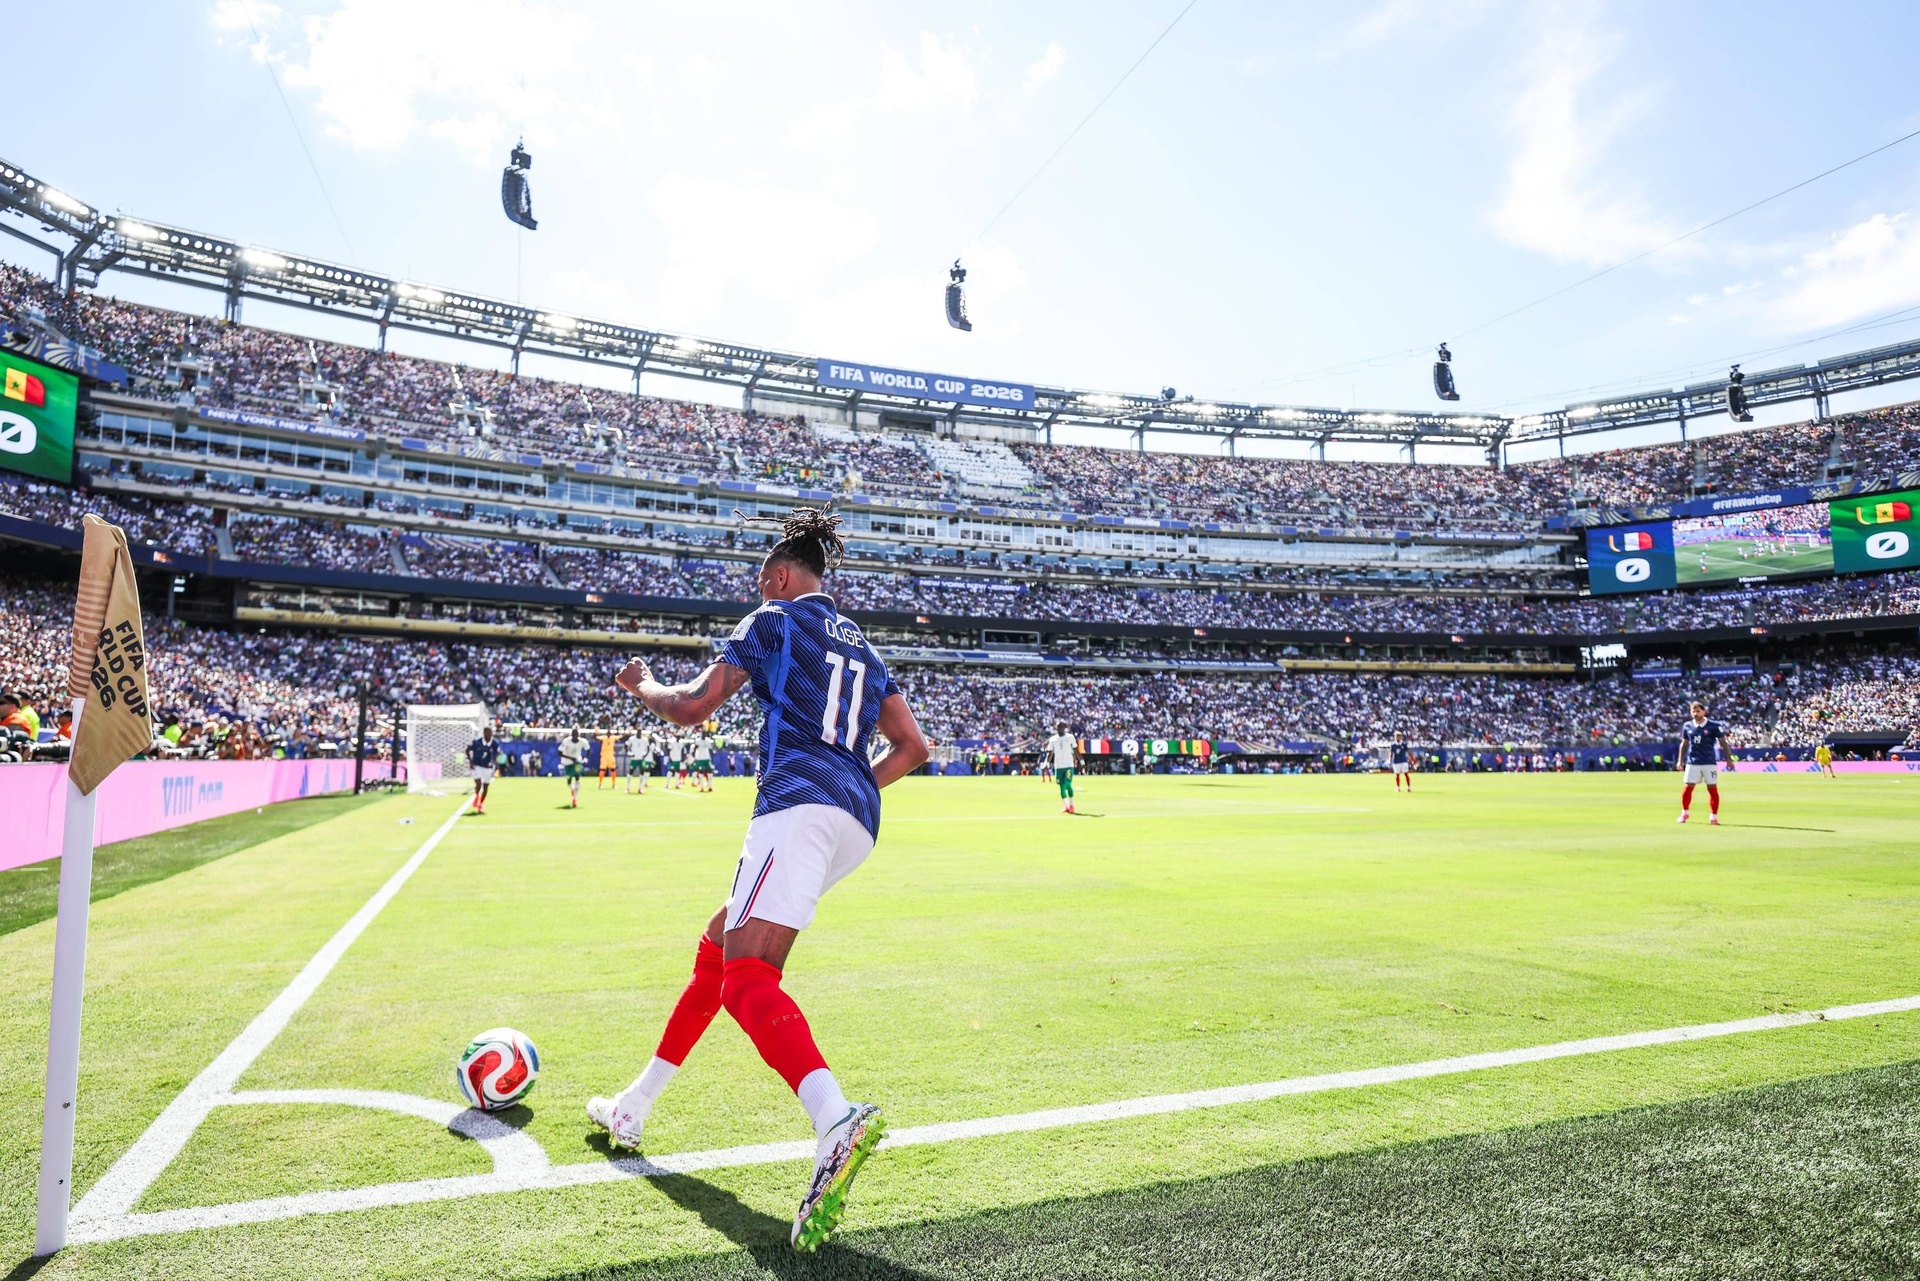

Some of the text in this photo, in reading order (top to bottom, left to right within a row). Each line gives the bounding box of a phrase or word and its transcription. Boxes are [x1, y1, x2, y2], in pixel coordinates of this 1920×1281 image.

[830, 365, 1024, 401] FIFA WORLD CUP 2026
[207, 409, 359, 439] NEW YORK NEW JERSEY
[1712, 494, 1782, 511] #FIFAWorldCup
[919, 579, 940, 587] NEW
[941, 580, 966, 588] YORK
[988, 584, 1021, 592] JERSEY
[115, 619, 145, 672] FIFA
[825, 618, 864, 648] OLISE
[98, 627, 148, 718] RLD CUP
